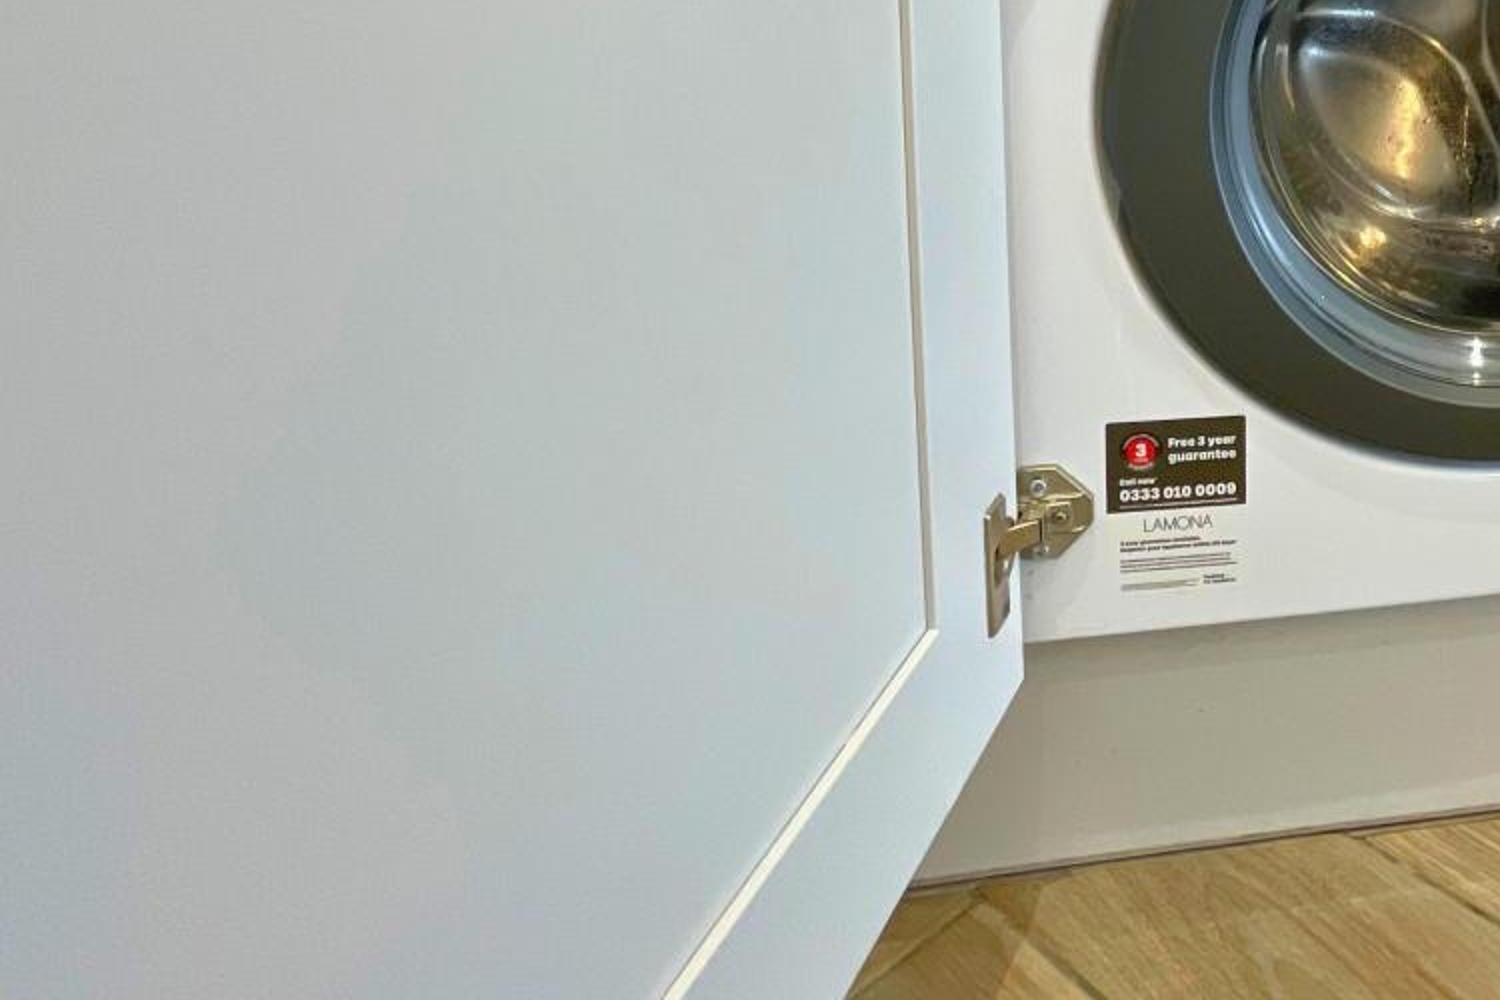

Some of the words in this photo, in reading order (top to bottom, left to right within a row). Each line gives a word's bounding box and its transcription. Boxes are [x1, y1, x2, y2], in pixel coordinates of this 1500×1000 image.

[1167, 437, 1195, 449] Free
[1197, 435, 1206, 447] 3
[1207, 434, 1237, 448] year
[1134, 443, 1147, 458] 3
[1167, 448, 1238, 465] guarantee
[1119, 487, 1161, 503] 0333
[1163, 485, 1192, 500] 010
[1143, 513, 1213, 533] LAMONA
